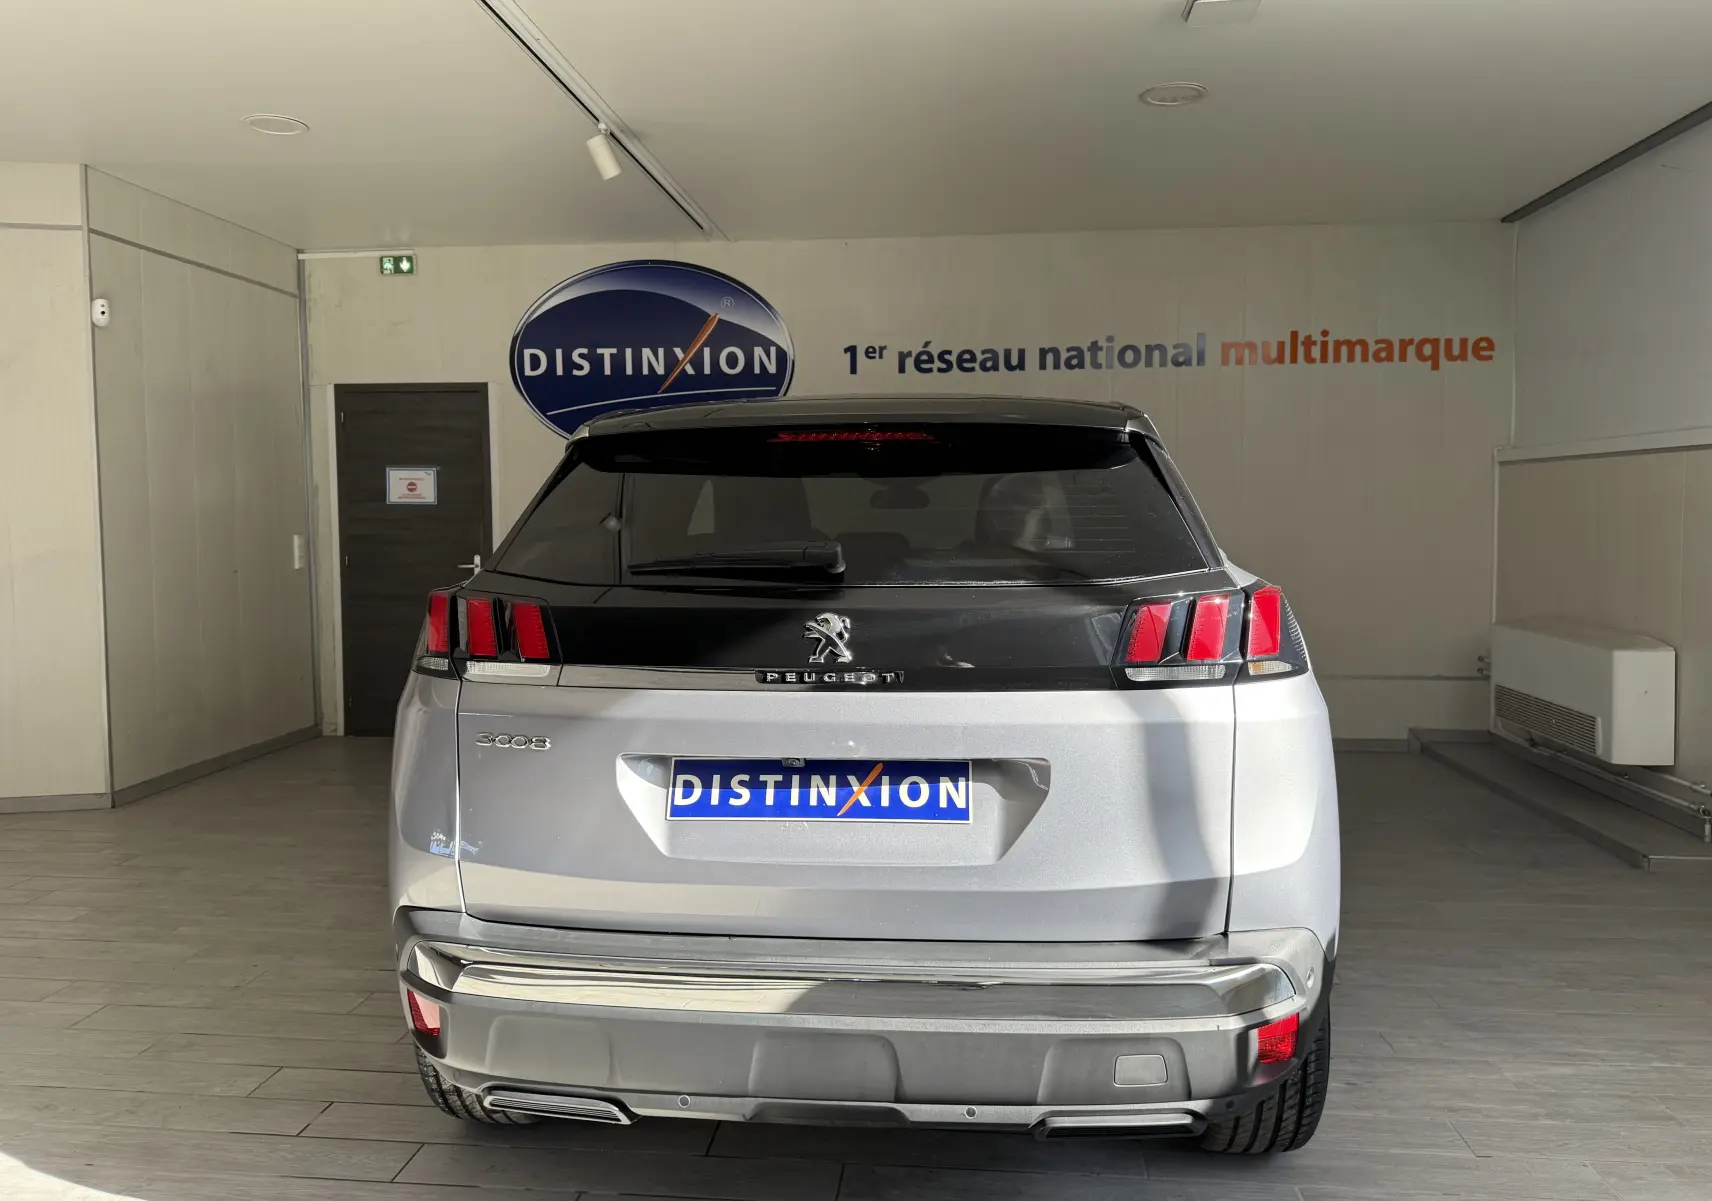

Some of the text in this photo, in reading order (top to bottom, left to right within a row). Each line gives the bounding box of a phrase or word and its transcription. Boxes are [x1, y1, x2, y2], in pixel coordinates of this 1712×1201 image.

[523, 345, 777, 377] DISTINXION
[843, 329, 1496, 375] 1er réseau national multimarque
[766, 672, 895, 682] PEUGEOT
[475, 732, 552, 751] 3008
[673, 773, 968, 809] DISTINXION
